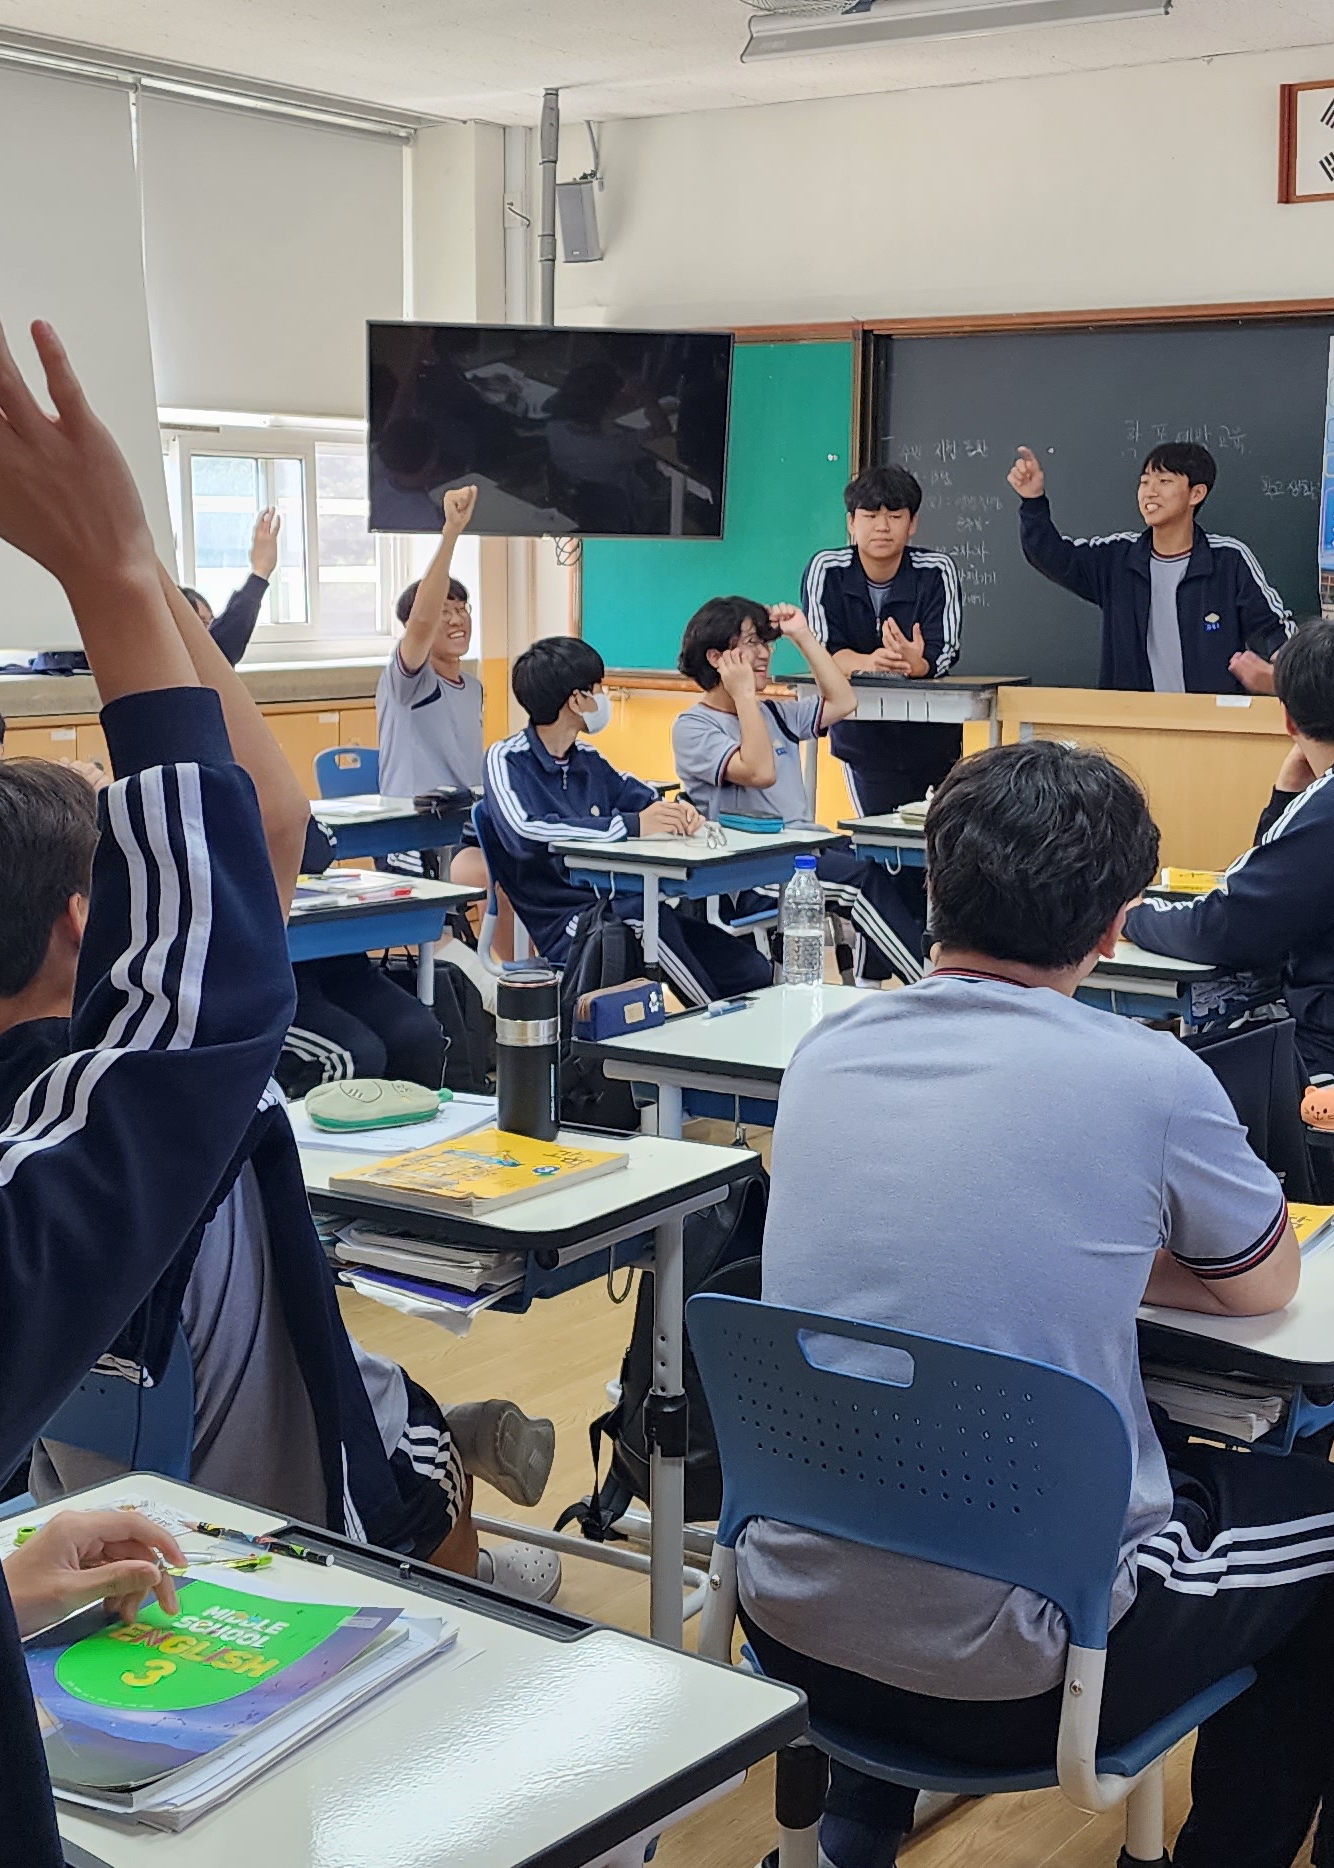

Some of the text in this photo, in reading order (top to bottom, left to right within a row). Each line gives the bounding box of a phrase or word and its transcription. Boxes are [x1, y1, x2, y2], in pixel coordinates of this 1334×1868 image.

[172, 1616, 270, 1648] SCHOOL
[202, 1606, 290, 1634] MIDDLE
[110, 1623, 279, 1678] ENGLISH
[121, 1659, 176, 1687] 3
